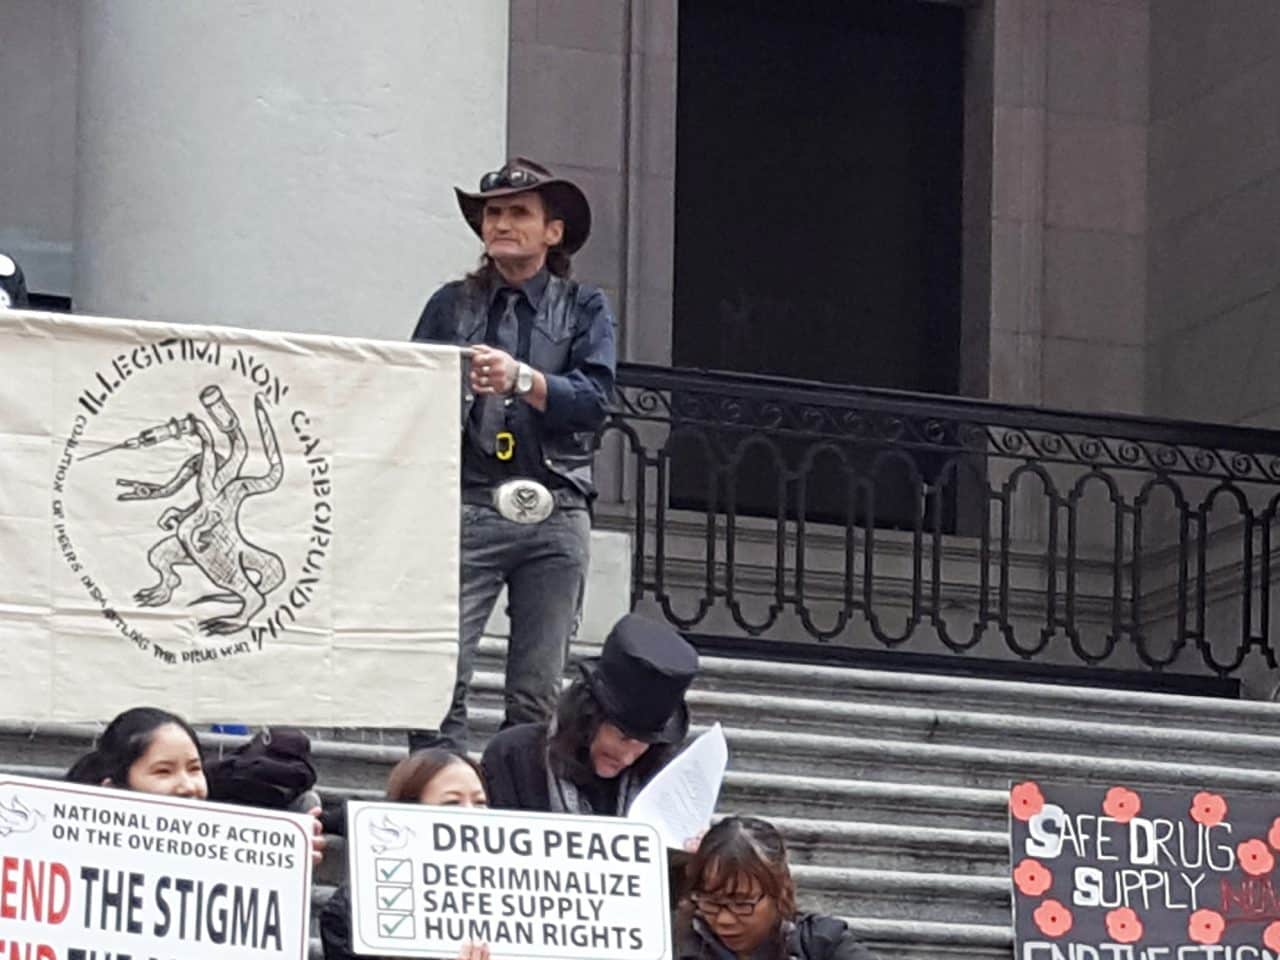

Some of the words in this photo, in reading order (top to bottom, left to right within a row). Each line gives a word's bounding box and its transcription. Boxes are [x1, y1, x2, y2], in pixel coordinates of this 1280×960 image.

[79, 338, 221, 416] ILLEGITIMI
[231, 350, 289, 405] NON
[52, 824, 80, 842] ON
[86, 828, 123, 847] THE
[128, 834, 229, 862] OVERDOSE
[235, 848, 296, 869] CRISIS
[53, 803, 150, 830] NATIONAL
[156, 817, 192, 835] DAY
[198, 822, 221, 838] OF
[227, 827, 296, 849] ACTION
[433, 822, 532, 857] DRUG
[544, 830, 652, 864] PEACE
[1025, 803, 1120, 861] SAFE
[1129, 818, 1236, 872] DRUG
[422, 863, 642, 897] DECRIMINALIZE
[1073, 867, 1205, 910] SUPPLY
[1, 856, 72, 925] END
[80, 866, 145, 934] THE
[154, 876, 283, 951] STIGMA
[424, 890, 493, 916] SAFE
[502, 894, 604, 922] SUPPLY
[425, 917, 534, 945] HUMAN
[543, 924, 644, 951] RIGHTS
